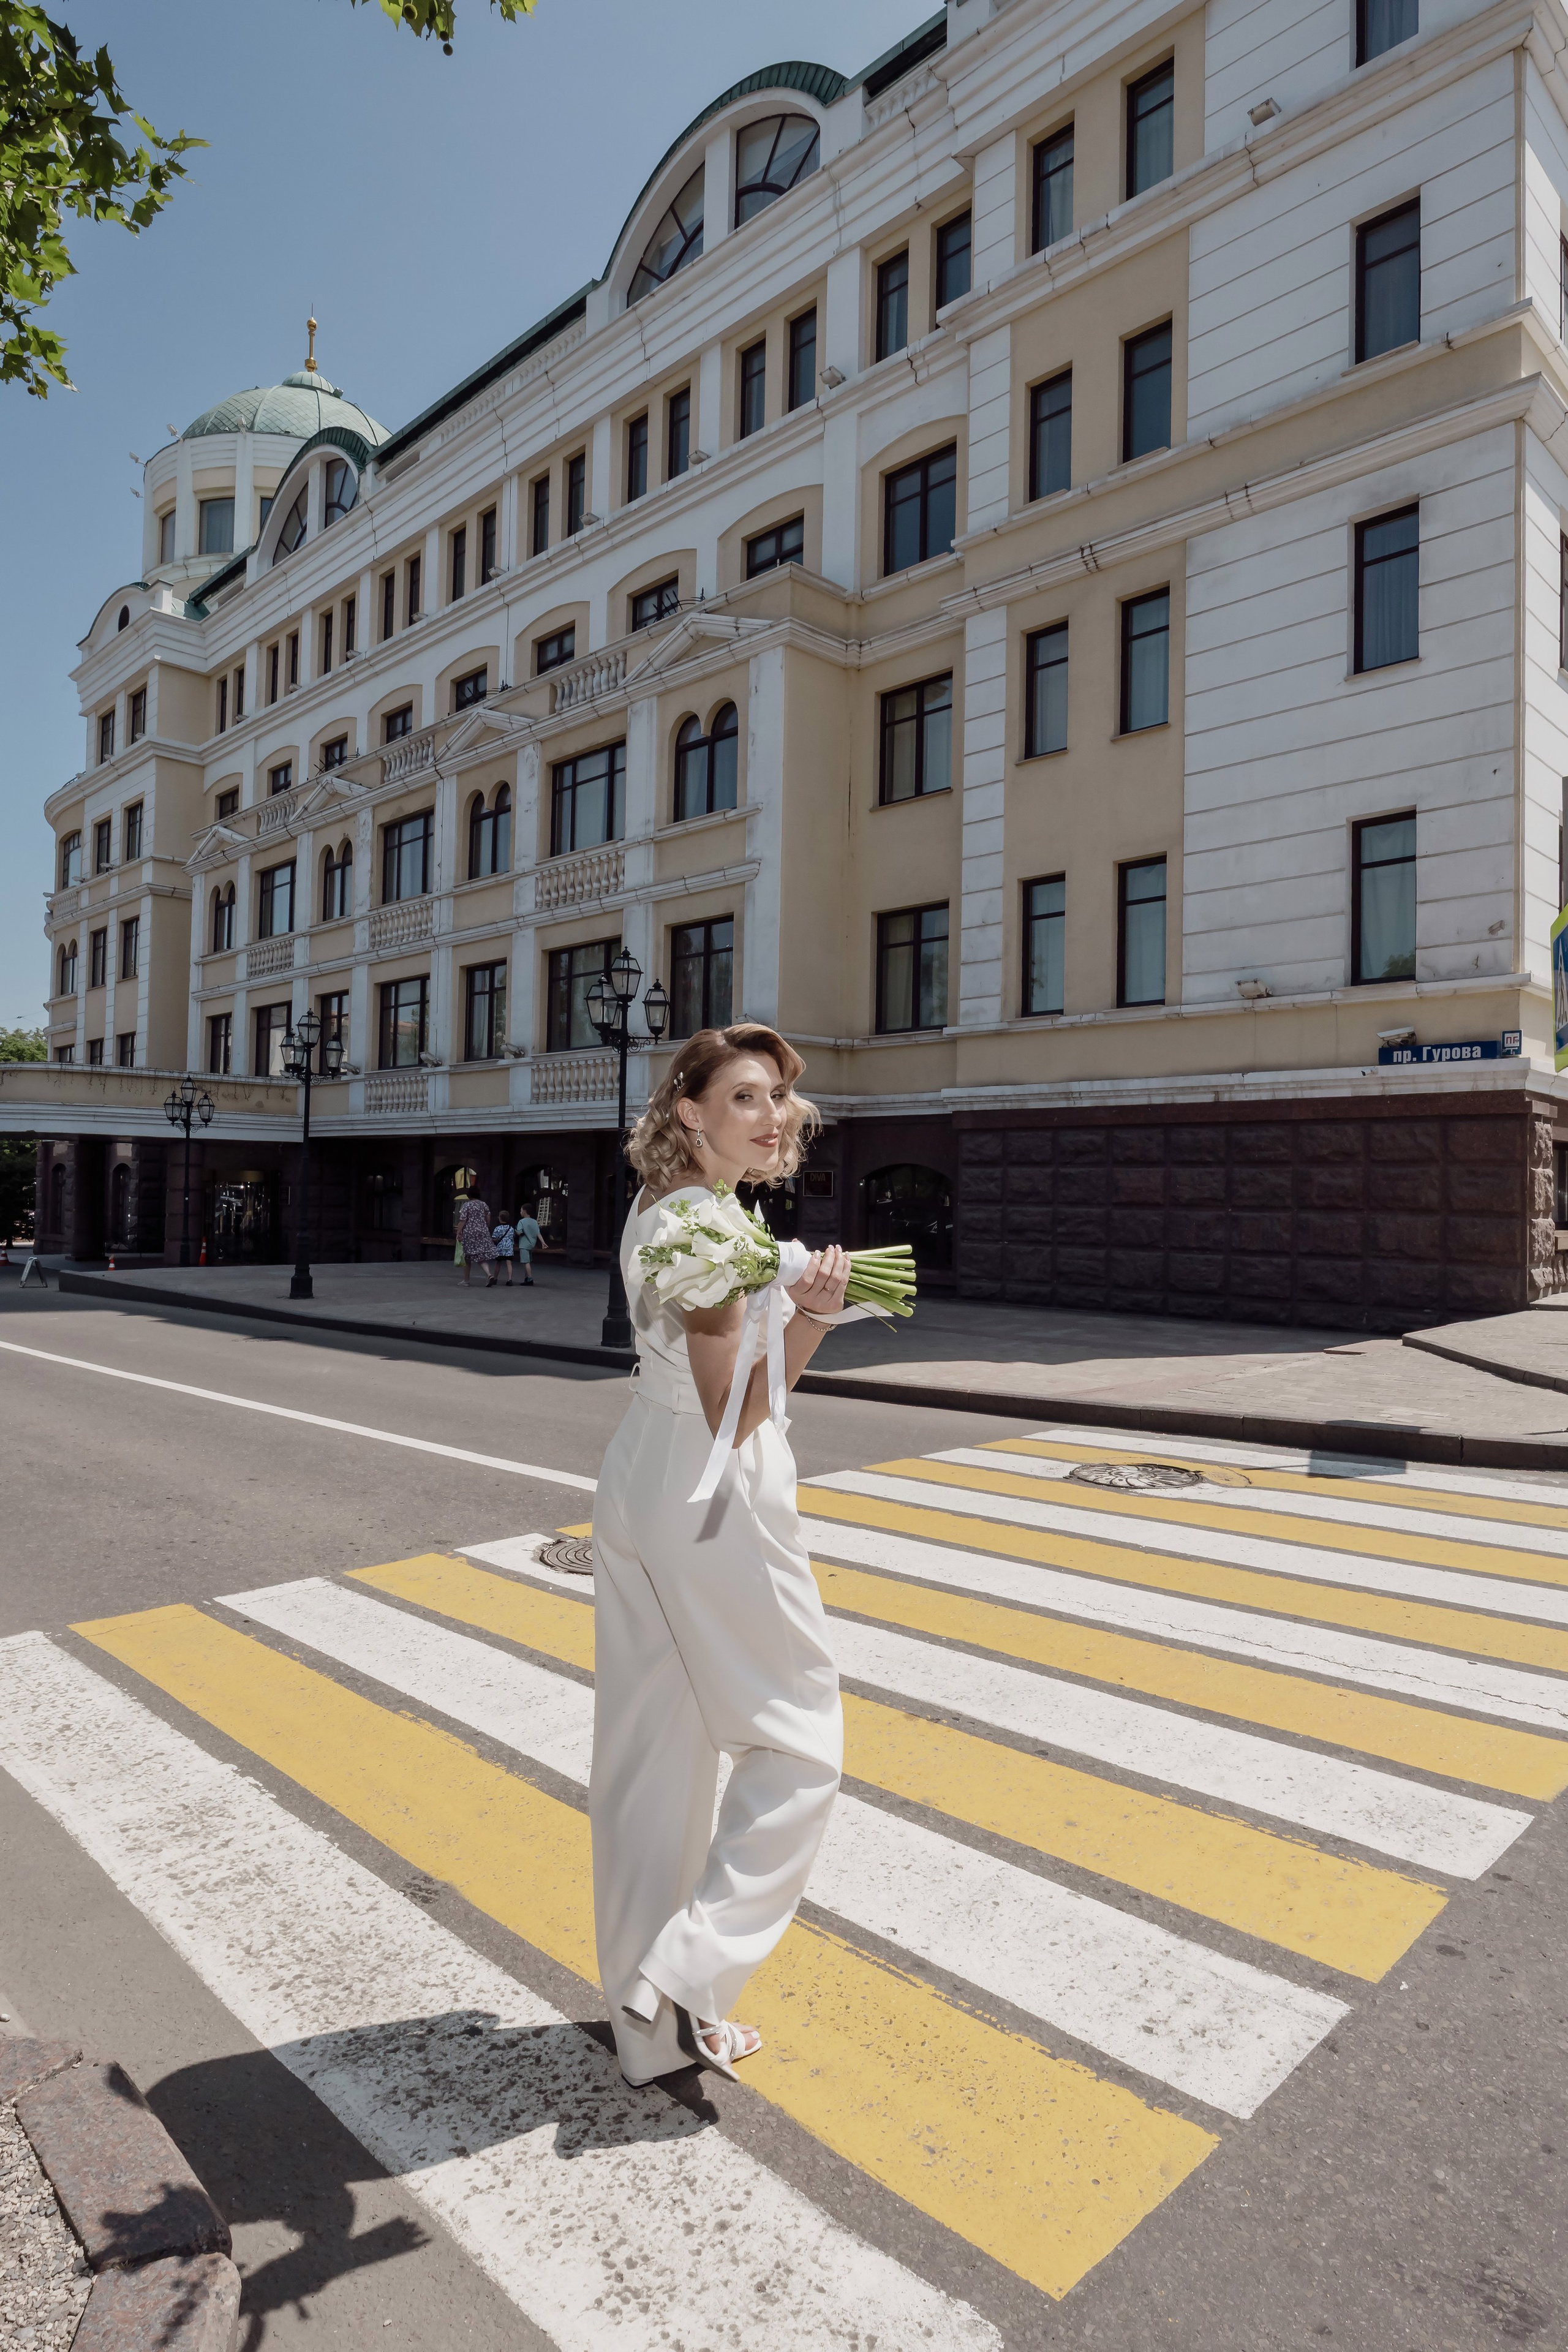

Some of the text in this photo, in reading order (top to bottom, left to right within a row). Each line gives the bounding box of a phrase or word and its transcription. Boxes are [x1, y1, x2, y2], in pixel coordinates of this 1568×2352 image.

[1393, 1046, 1481, 1064] пр. Гурова
[810, 1172, 826, 1182] DIVA
